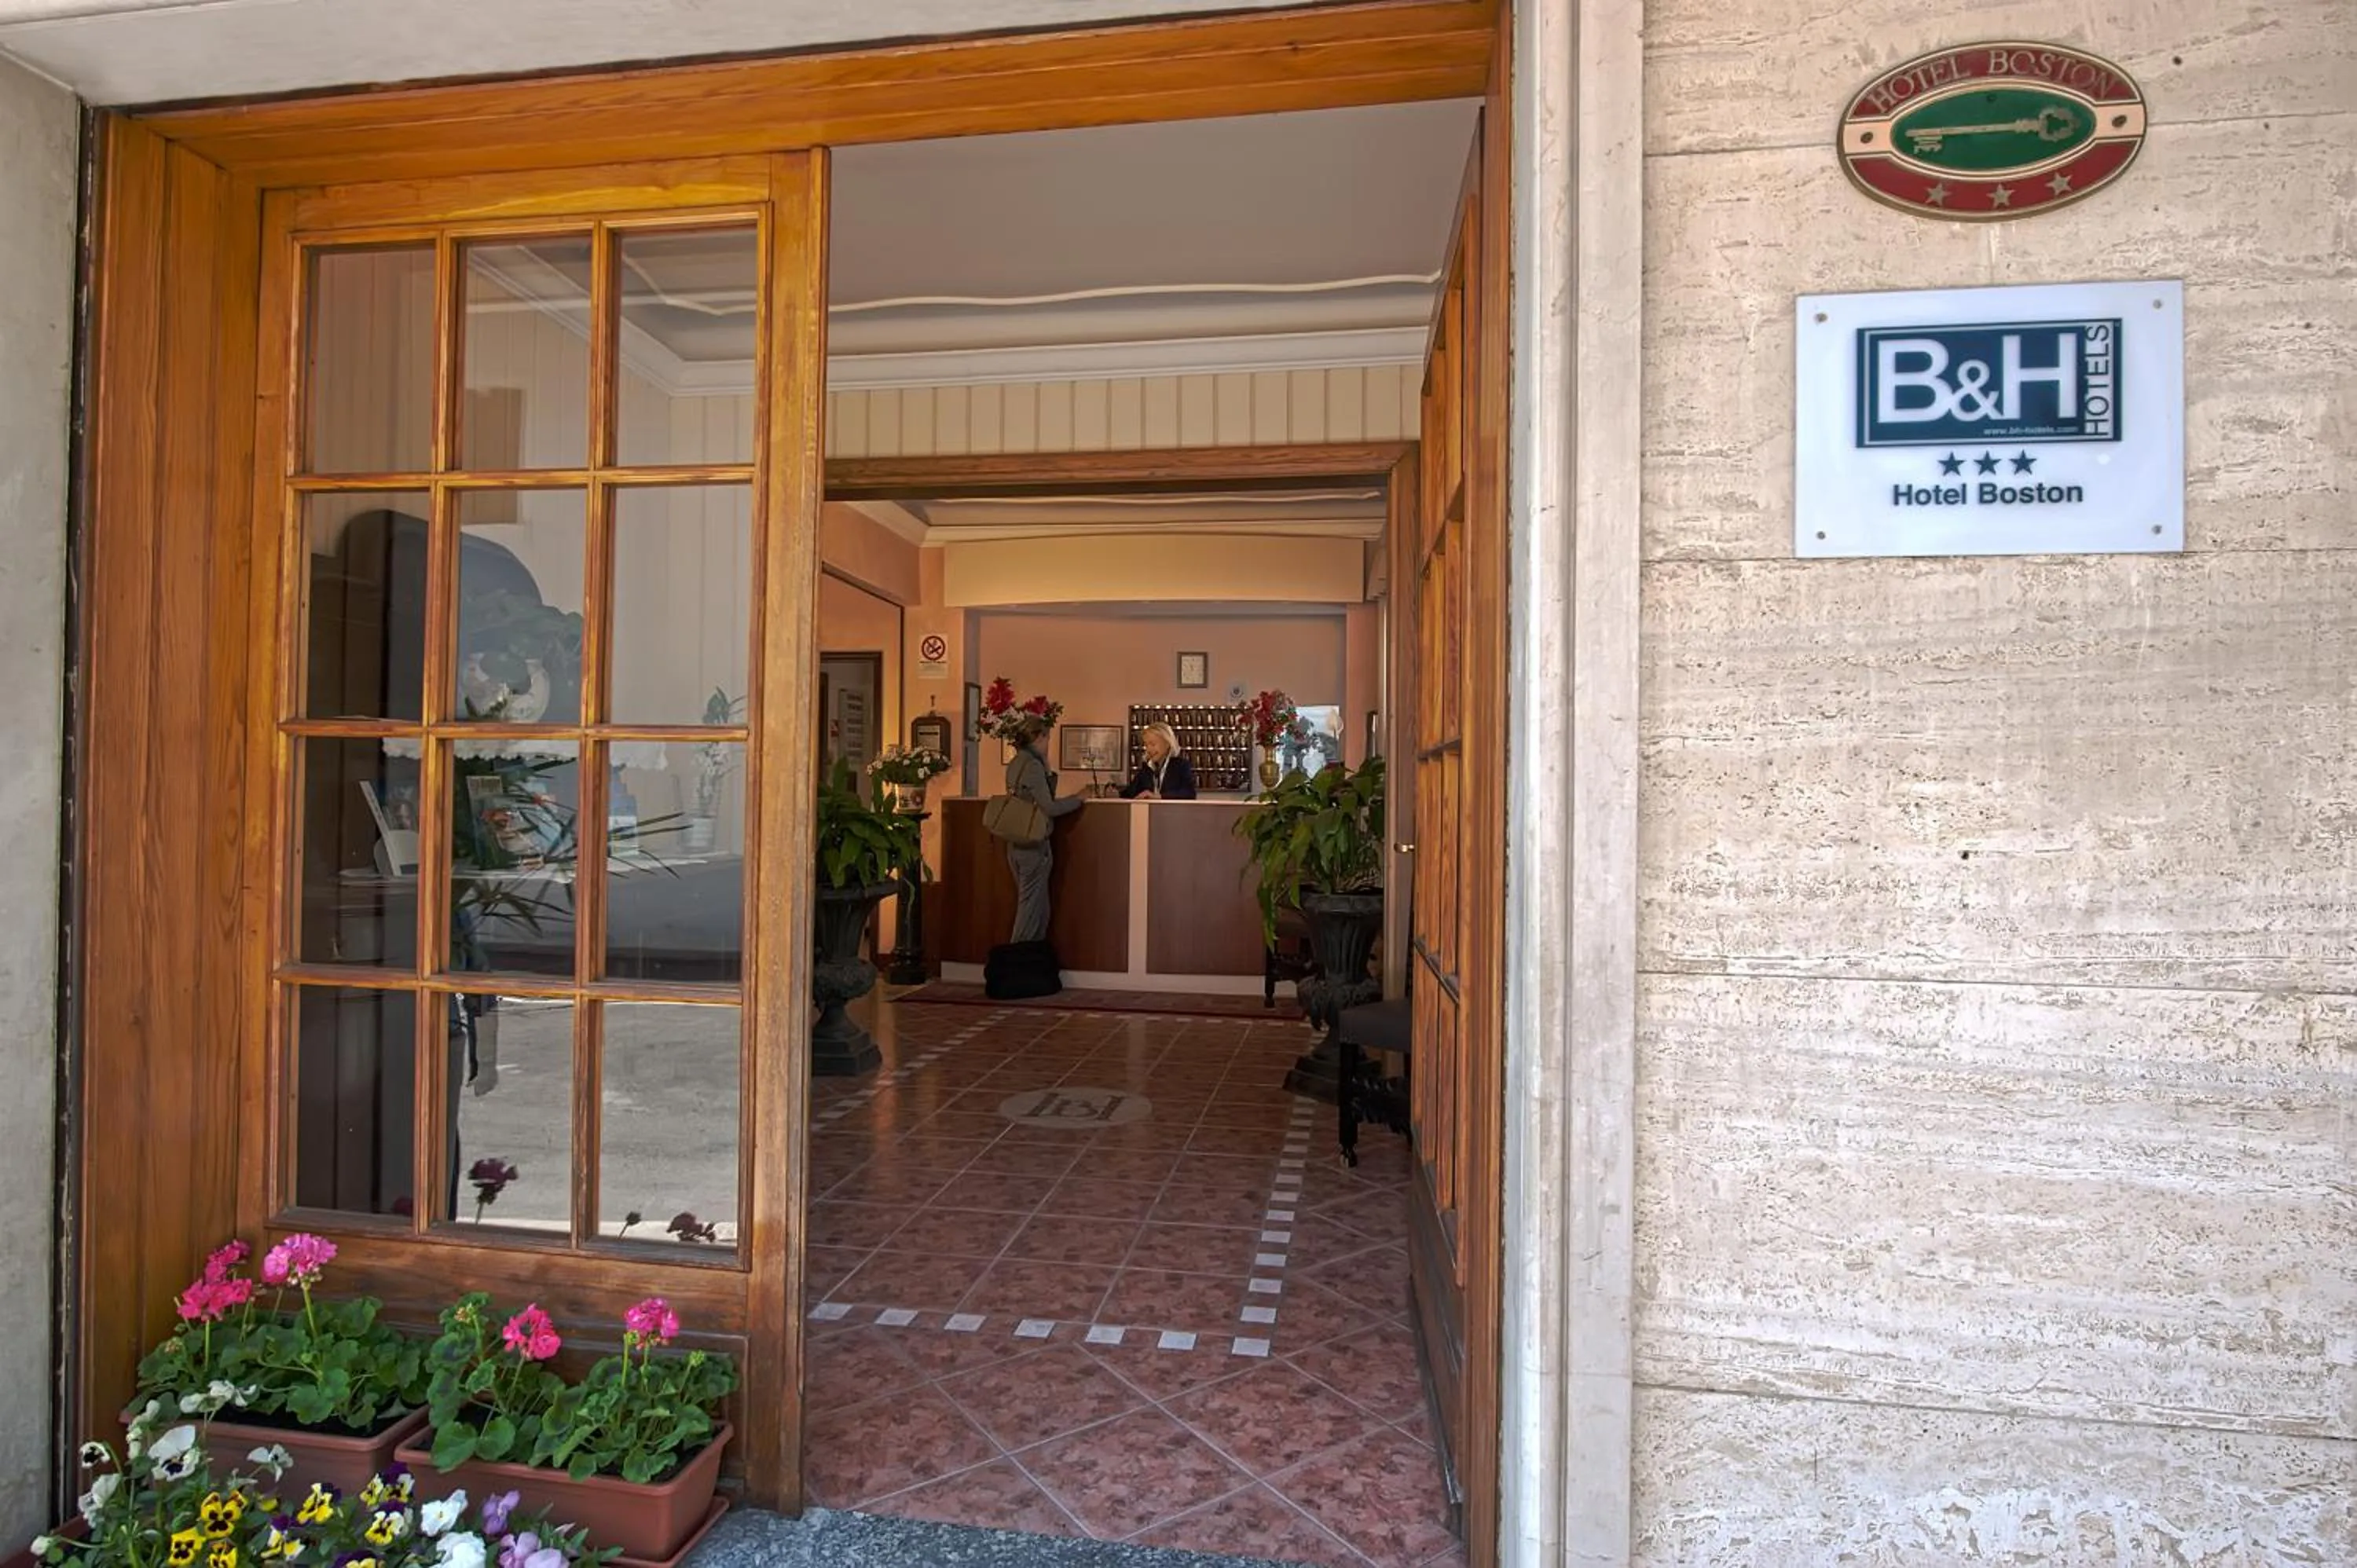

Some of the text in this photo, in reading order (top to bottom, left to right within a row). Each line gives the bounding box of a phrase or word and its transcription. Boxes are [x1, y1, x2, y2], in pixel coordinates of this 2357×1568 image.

[1866, 49, 2115, 113] HOTEL BOSTON
[1877, 332, 2077, 423] B&H
[2084, 324, 2110, 436] HOTELS
[1893, 482, 2084, 506] Hotel Boston
